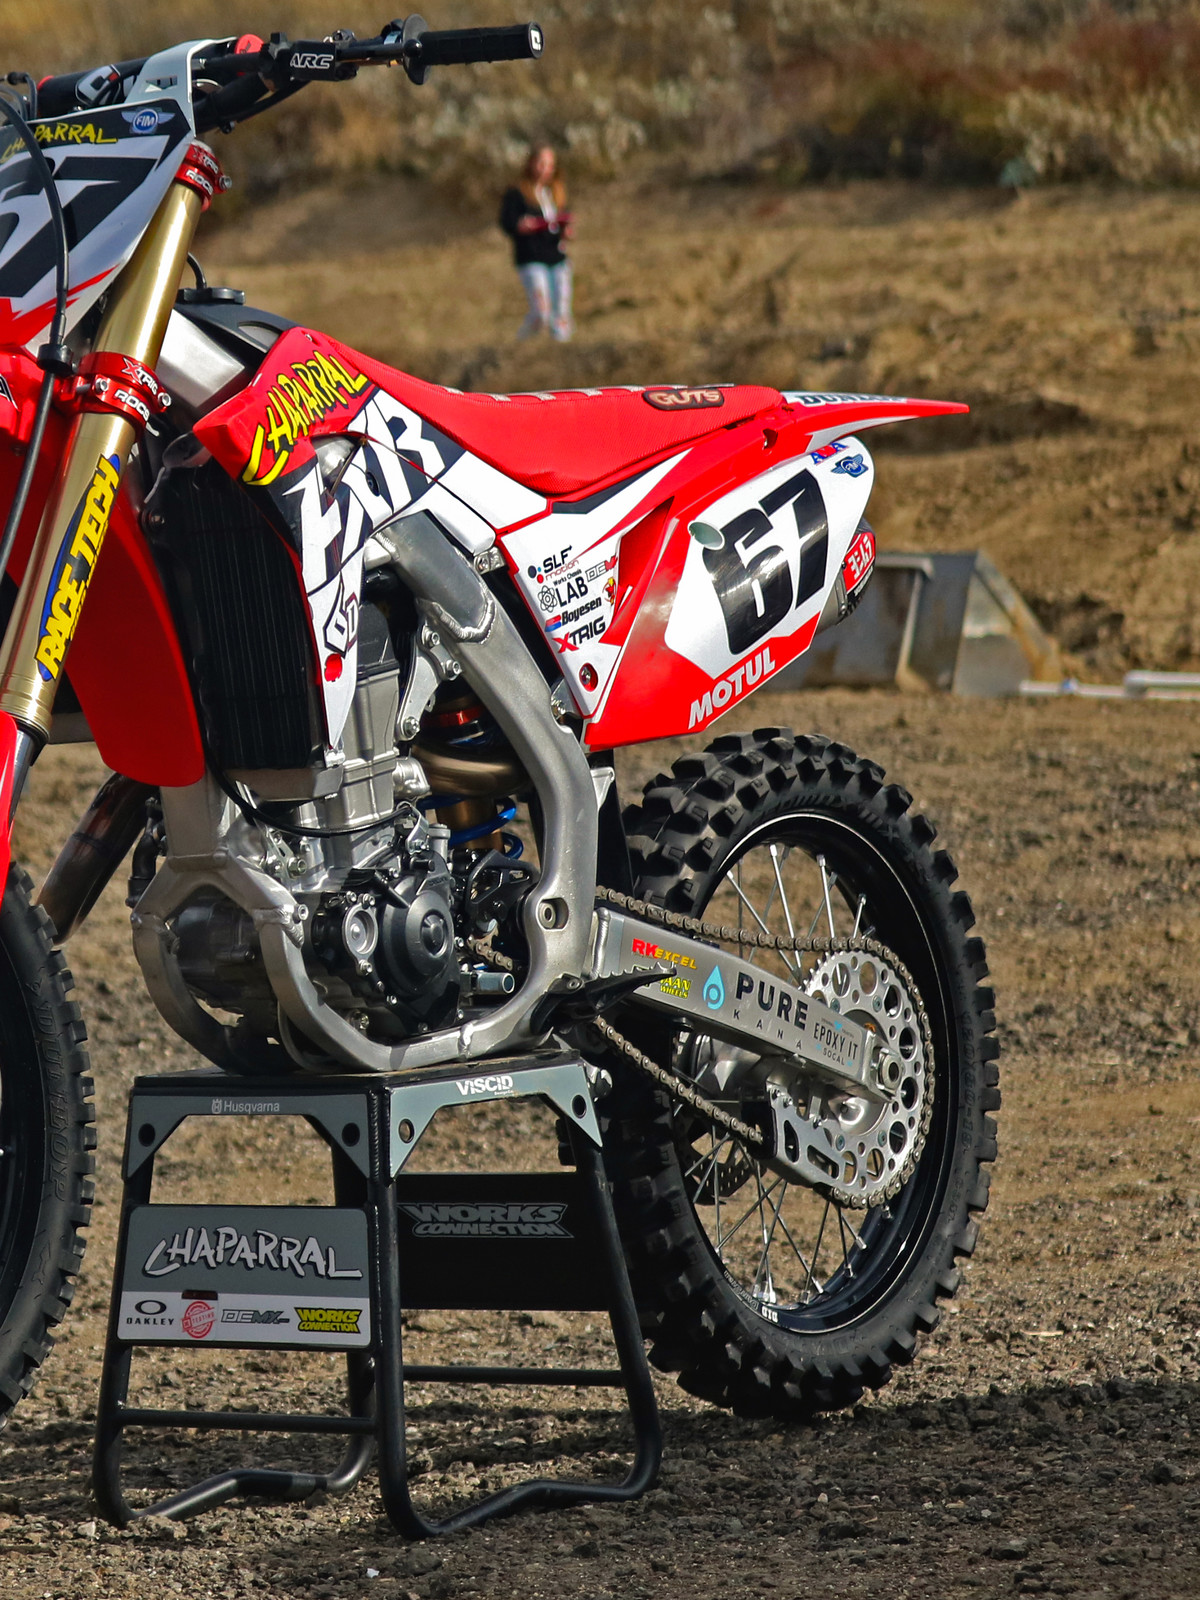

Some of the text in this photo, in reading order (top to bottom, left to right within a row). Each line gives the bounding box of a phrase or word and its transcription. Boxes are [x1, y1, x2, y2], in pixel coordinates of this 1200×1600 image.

[290, 53, 334, 69] ARC
[650, 387, 721, 407] GUTS
[242, 350, 369, 486] CHAPARRAL
[34, 561, 87, 680] RACE
[68, 453, 121, 567] TECH
[543, 545, 573, 574] SLF
[545, 559, 580, 581] motion
[702, 468, 828, 655] 67
[555, 576, 589, 608] LAB
[561, 596, 603, 627] Boyesen
[551, 615, 607, 654] XTRIG
[687, 646, 776, 730] MOTUL
[631, 938, 698, 970] RK EXCEL
[736, 971, 809, 1032] PURE
[813, 1022, 858, 1060] EPOXY IT
[823, 1047, 845, 1066] SOCAL
[456, 1075, 514, 1096] VISCID
[224, 1100, 280, 1114] Husqvarna
[403, 1203, 568, 1223] WORKS
[411, 1221, 572, 1238] CONNECTION
[143, 1226, 364, 1281] CHAPARRAL
[126, 1317, 174, 1326] OAKLEY
[296, 1308, 361, 1323] WORKS
[298, 1321, 360, 1333] CONNECTION
[761, 1305, 779, 1324] DID
